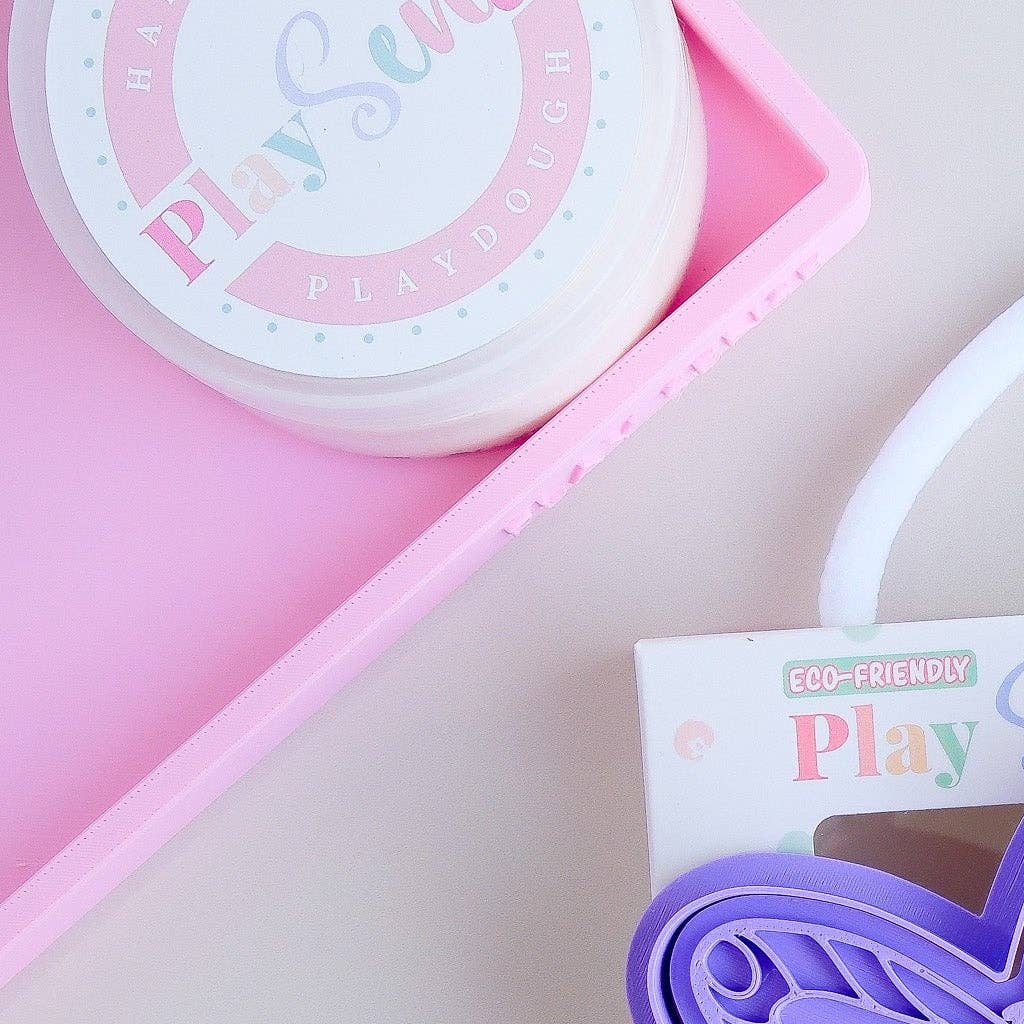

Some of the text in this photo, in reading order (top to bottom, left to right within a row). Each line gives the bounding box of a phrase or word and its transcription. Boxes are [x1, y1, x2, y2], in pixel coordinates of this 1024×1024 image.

[139, 109, 328, 287] Play
[305, 49, 573, 303] PLAYDOUGH
[788, 655, 971, 694] ECO-FRIENDLY
[789, 703, 979, 789] Play
